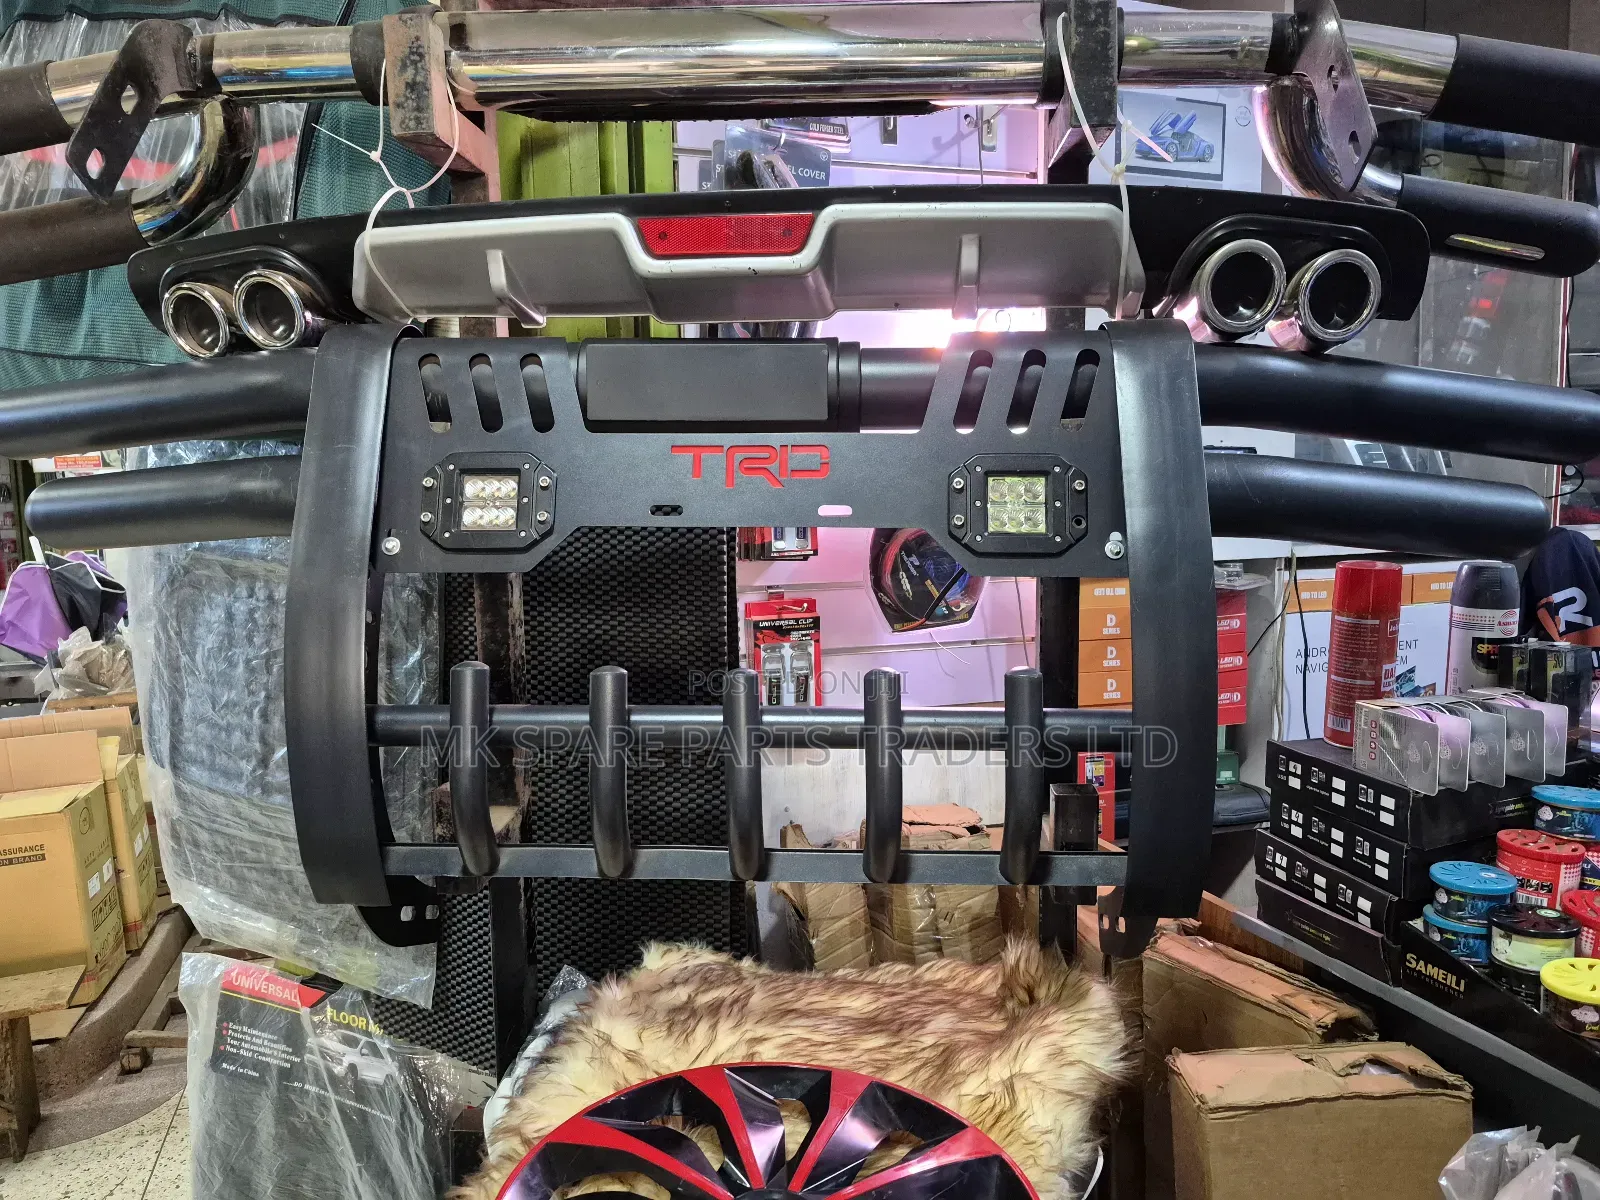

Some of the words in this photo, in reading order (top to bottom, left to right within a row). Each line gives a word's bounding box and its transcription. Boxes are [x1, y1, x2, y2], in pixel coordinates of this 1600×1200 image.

[798, 168, 826, 180] COVER
[671, 444, 830, 488] TRD
[760, 619, 797, 627] UNIVERSAL
[1106, 614, 1116, 626] D
[1107, 646, 1116, 659] D
[1296, 646, 1330, 659] ANDR
[1107, 678, 1116, 692] D
[12, 854, 44, 865] BRAND
[1406, 952, 1465, 992] SAMEILI
[232, 973, 300, 1002] UNIVERSAL
[326, 1007, 367, 1030] FLOOR
